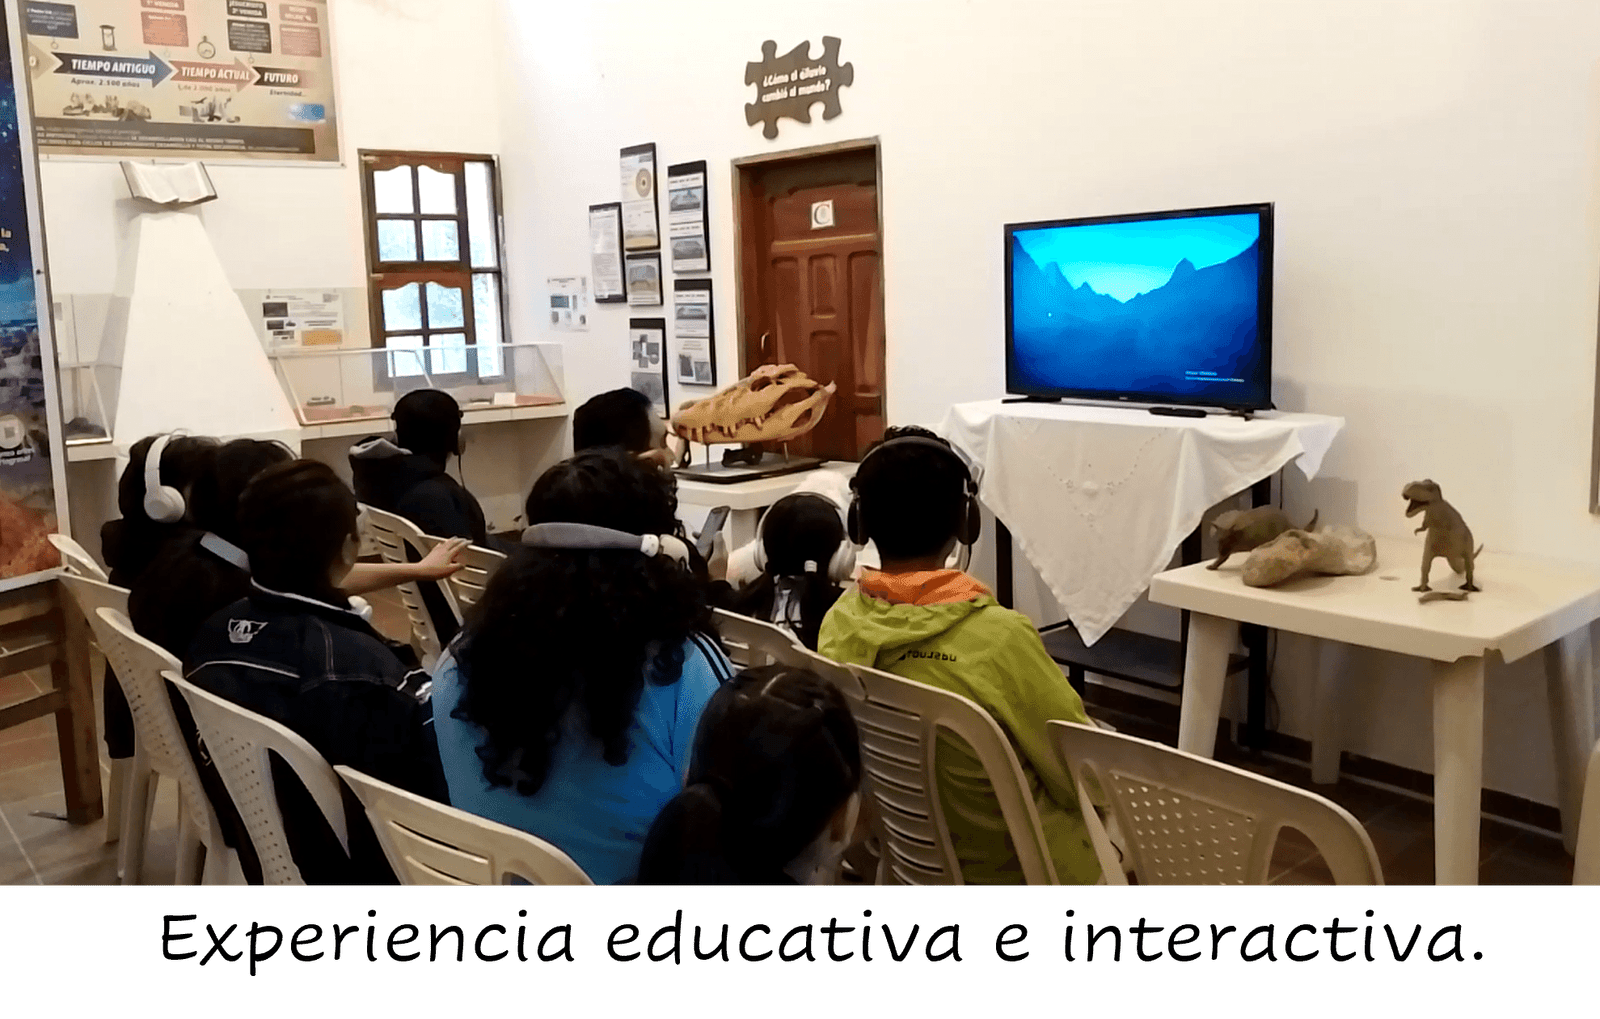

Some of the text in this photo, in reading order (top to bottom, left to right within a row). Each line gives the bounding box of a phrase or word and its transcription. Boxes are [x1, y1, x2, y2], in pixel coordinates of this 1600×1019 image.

[71, 59, 156, 75] TIEMPO ANTIGUO
[181, 66, 250, 81] TIEMPO ACTUAL
[264, 72, 299, 84] FUTURO
